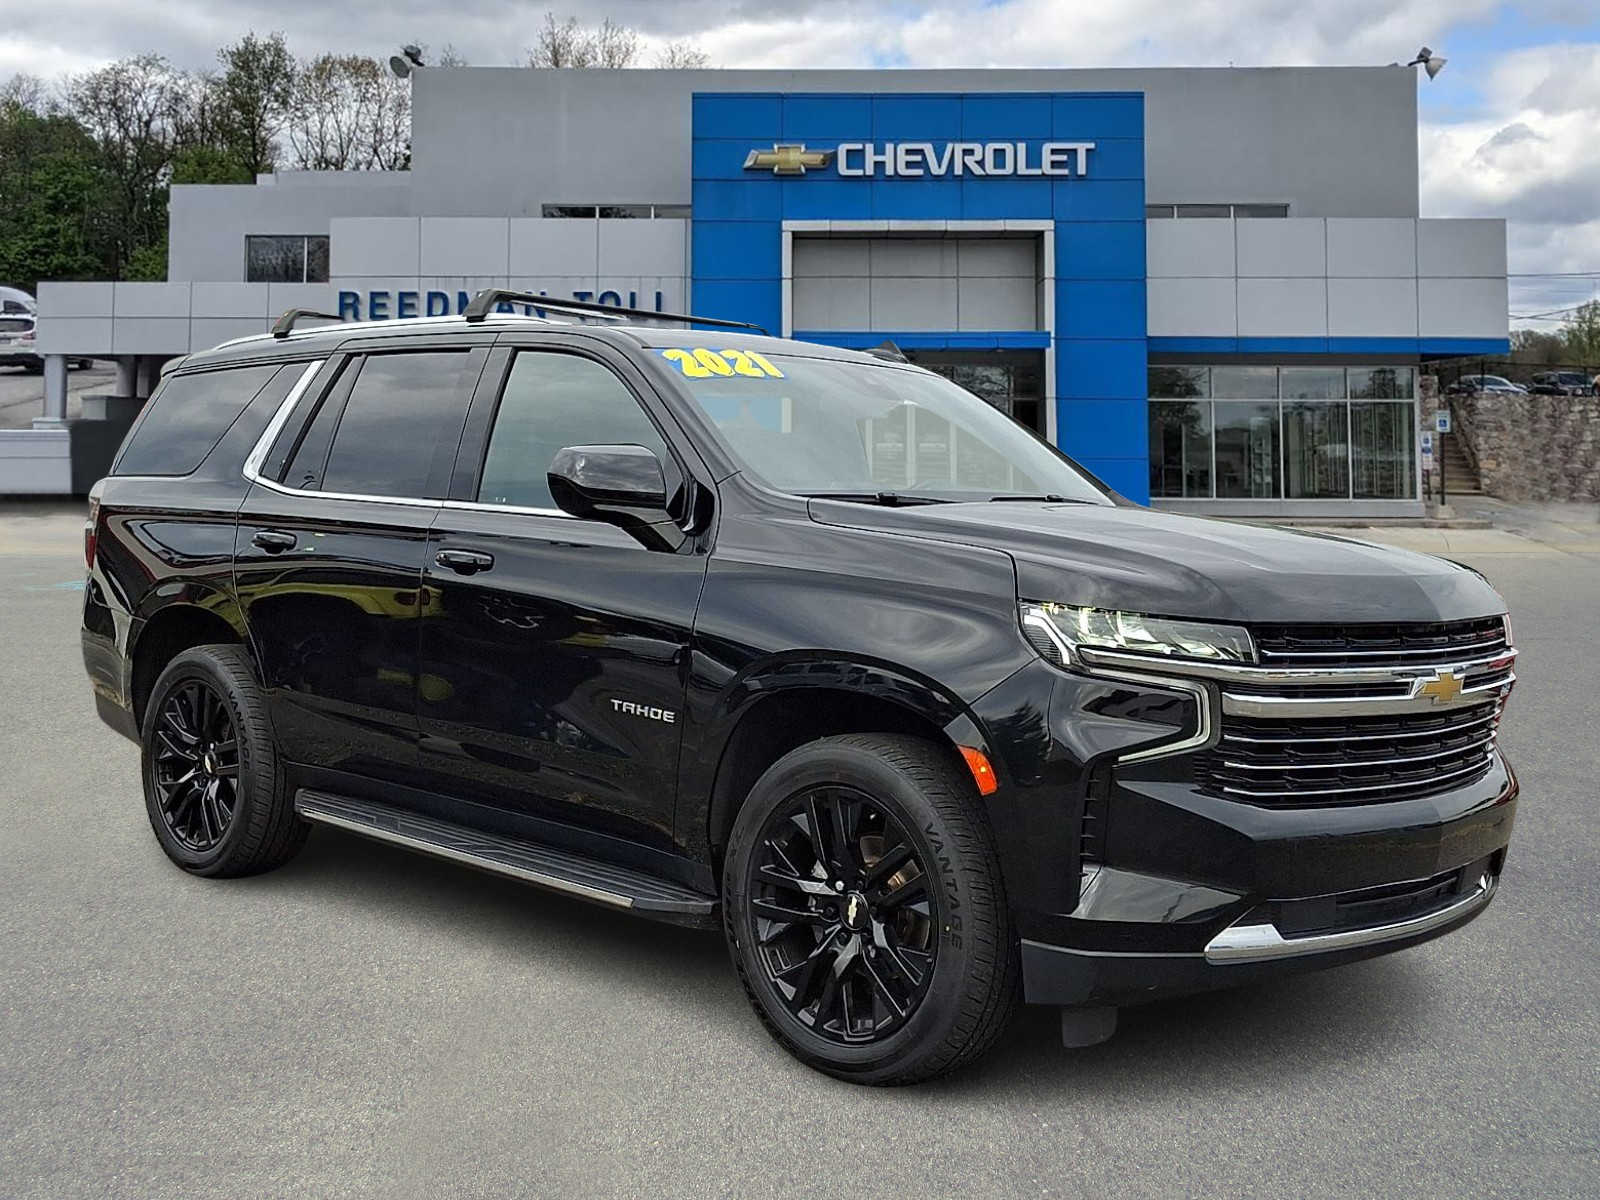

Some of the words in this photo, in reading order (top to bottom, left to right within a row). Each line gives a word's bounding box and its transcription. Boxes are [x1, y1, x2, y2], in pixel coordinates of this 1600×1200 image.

[837, 142, 1096, 176] CHEVROLET
[662, 348, 784, 378] 2021
[610, 699, 675, 723] TAHOE
[925, 822, 963, 950] VANTAGE
